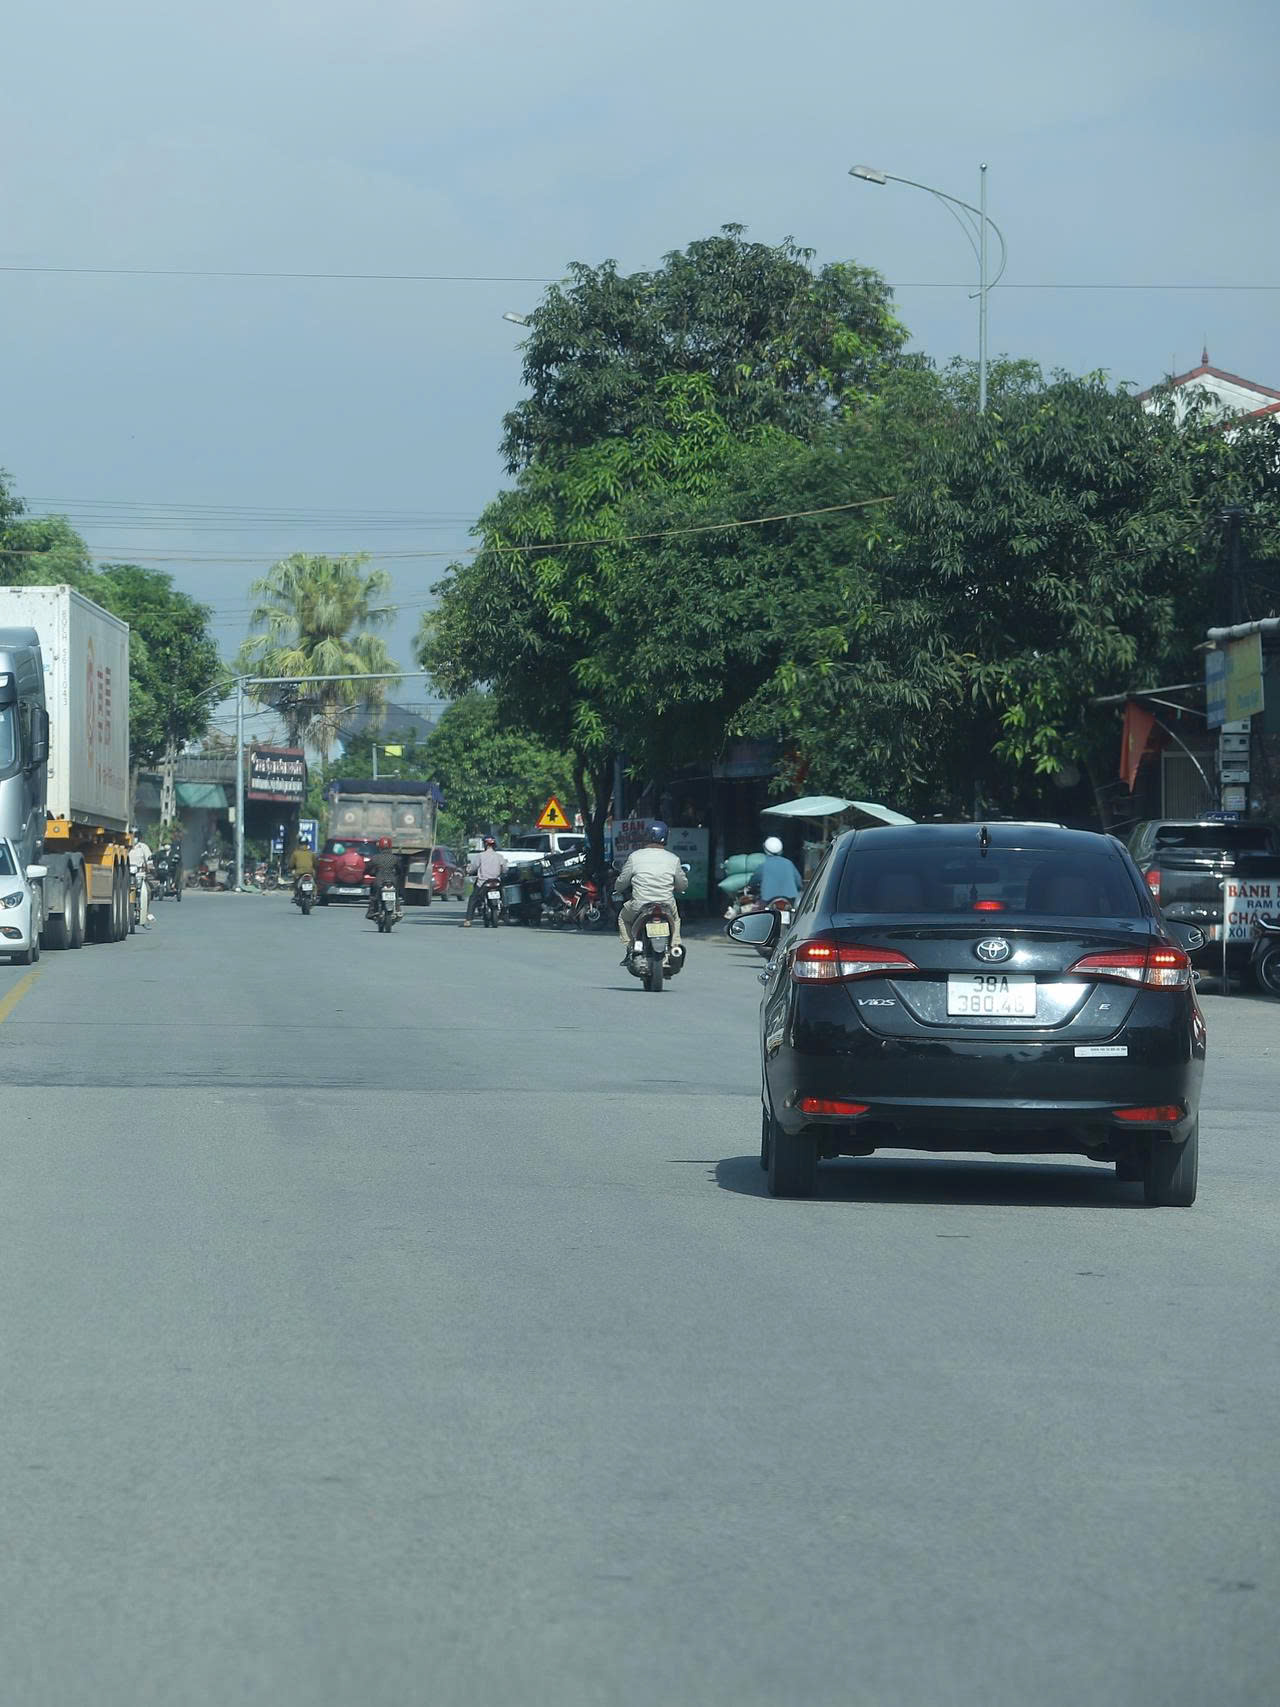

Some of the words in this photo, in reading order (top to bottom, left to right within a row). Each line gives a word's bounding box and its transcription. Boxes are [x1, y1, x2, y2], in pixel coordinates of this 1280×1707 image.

[1228, 881, 1271, 897] BÁNH
[1247, 899, 1273, 909] RAM
[973, 976, 1010, 993] 38A
